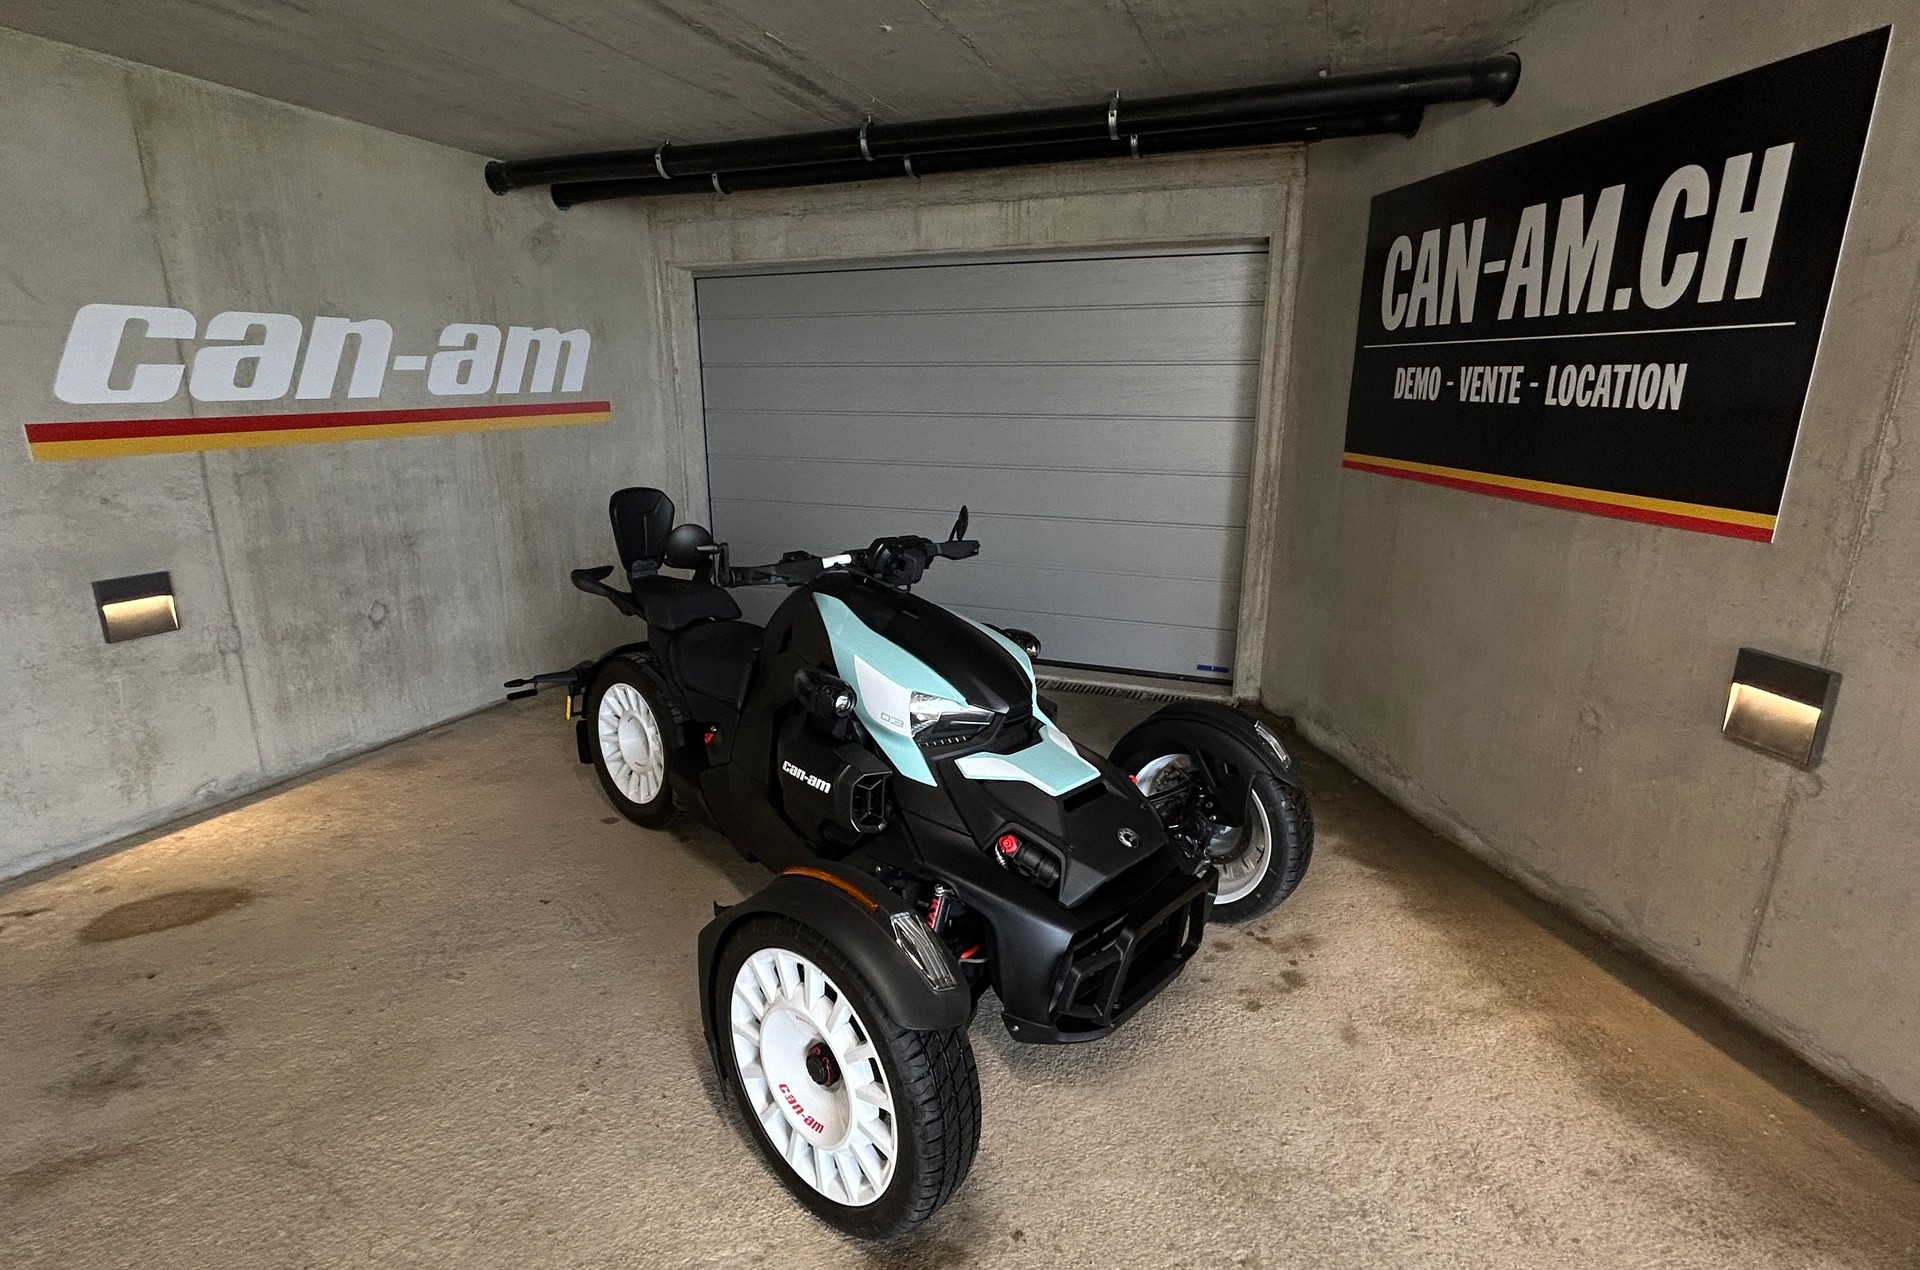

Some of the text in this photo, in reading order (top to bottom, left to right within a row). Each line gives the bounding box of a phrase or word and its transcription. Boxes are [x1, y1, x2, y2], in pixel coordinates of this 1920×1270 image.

[1381, 142, 1795, 331] CAN-AM.CH
[1394, 366, 1441, 401] DEMO
[1459, 365, 1524, 403] VENTE
[1544, 363, 1688, 410] LOCATION
[782, 760, 831, 793] can-am
[778, 1083, 824, 1134] can-am
